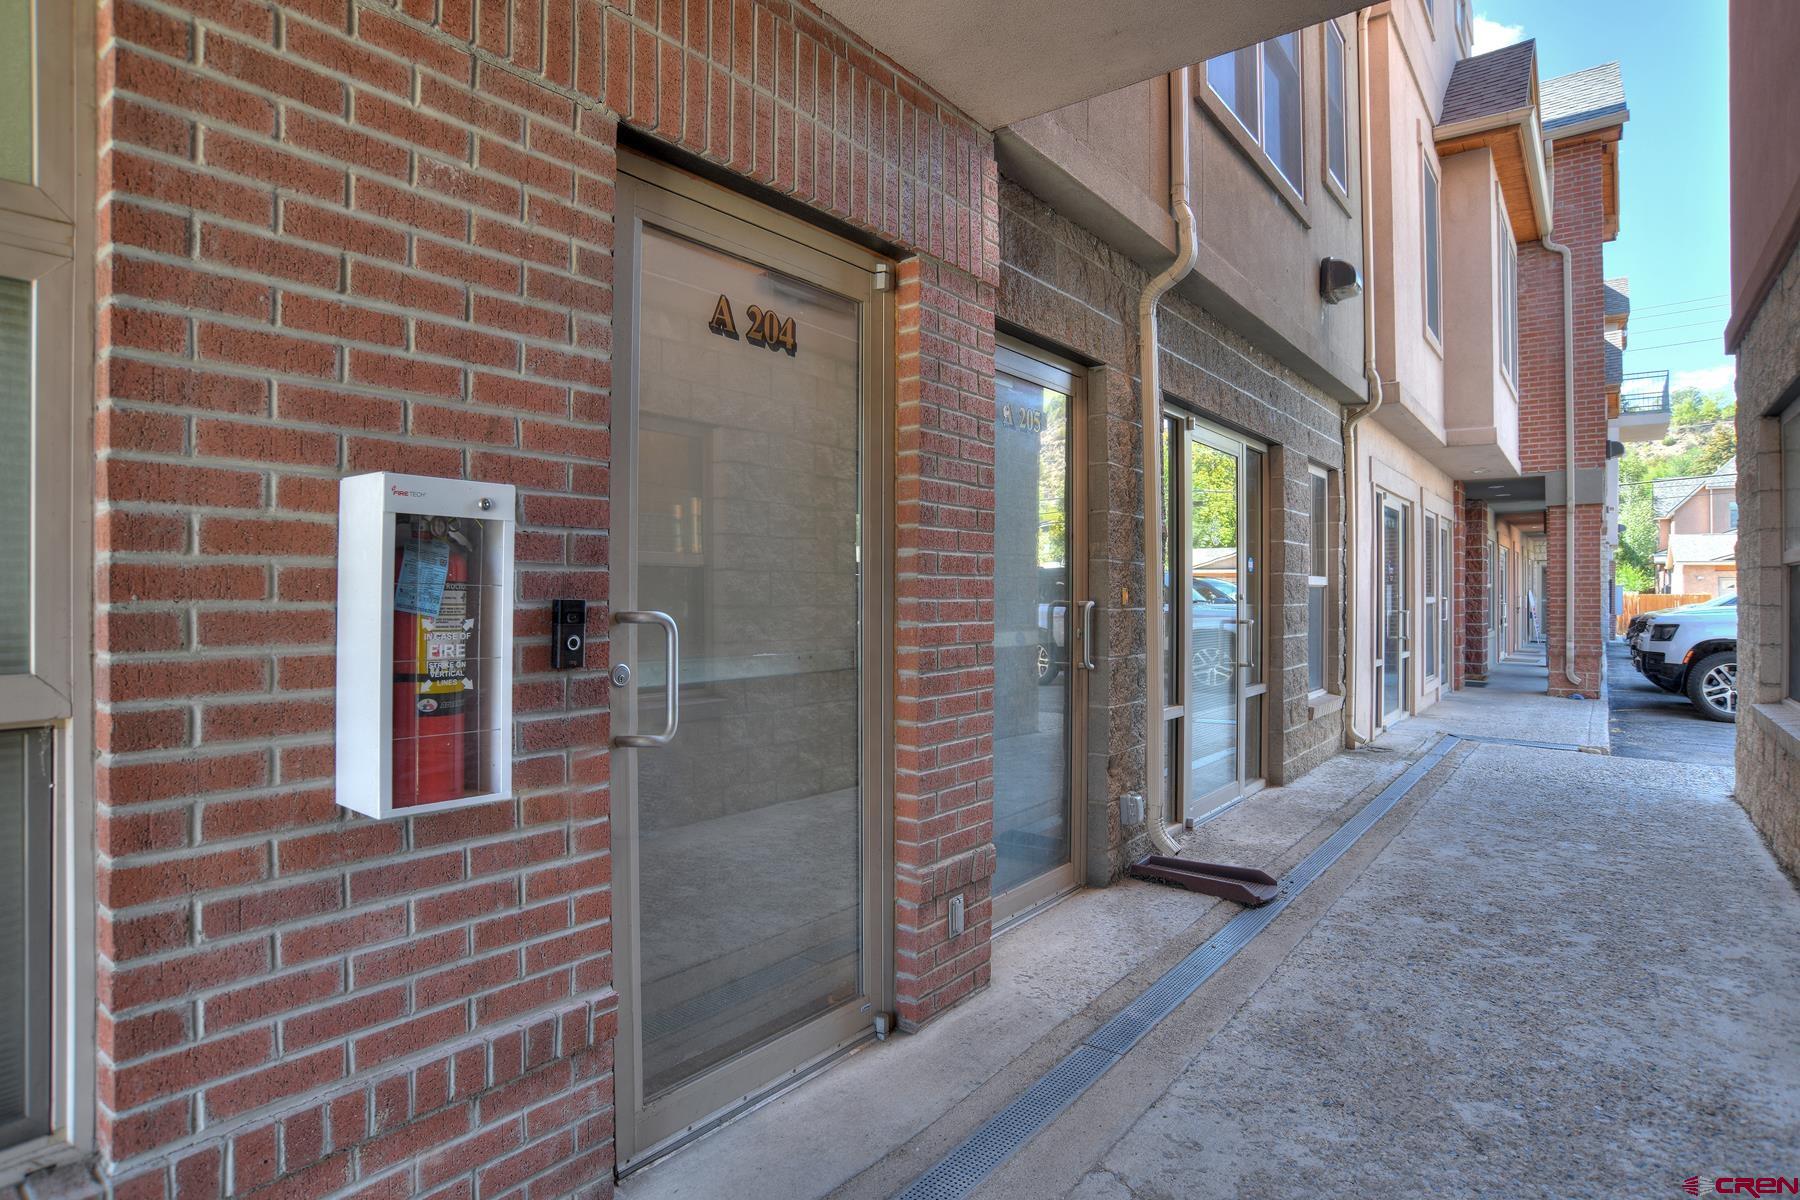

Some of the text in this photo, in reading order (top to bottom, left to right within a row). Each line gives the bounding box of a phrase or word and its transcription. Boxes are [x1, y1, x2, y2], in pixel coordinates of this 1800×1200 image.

[709, 294, 798, 357] A 204
[1019, 407, 1041, 433] 205
[424, 632, 472, 640] IN CASE OF
[430, 643, 466, 658] FIRE
[455, 660, 467, 668] ON
[429, 669, 465, 678] VERTICAL
[436, 679, 458, 687] LINES
